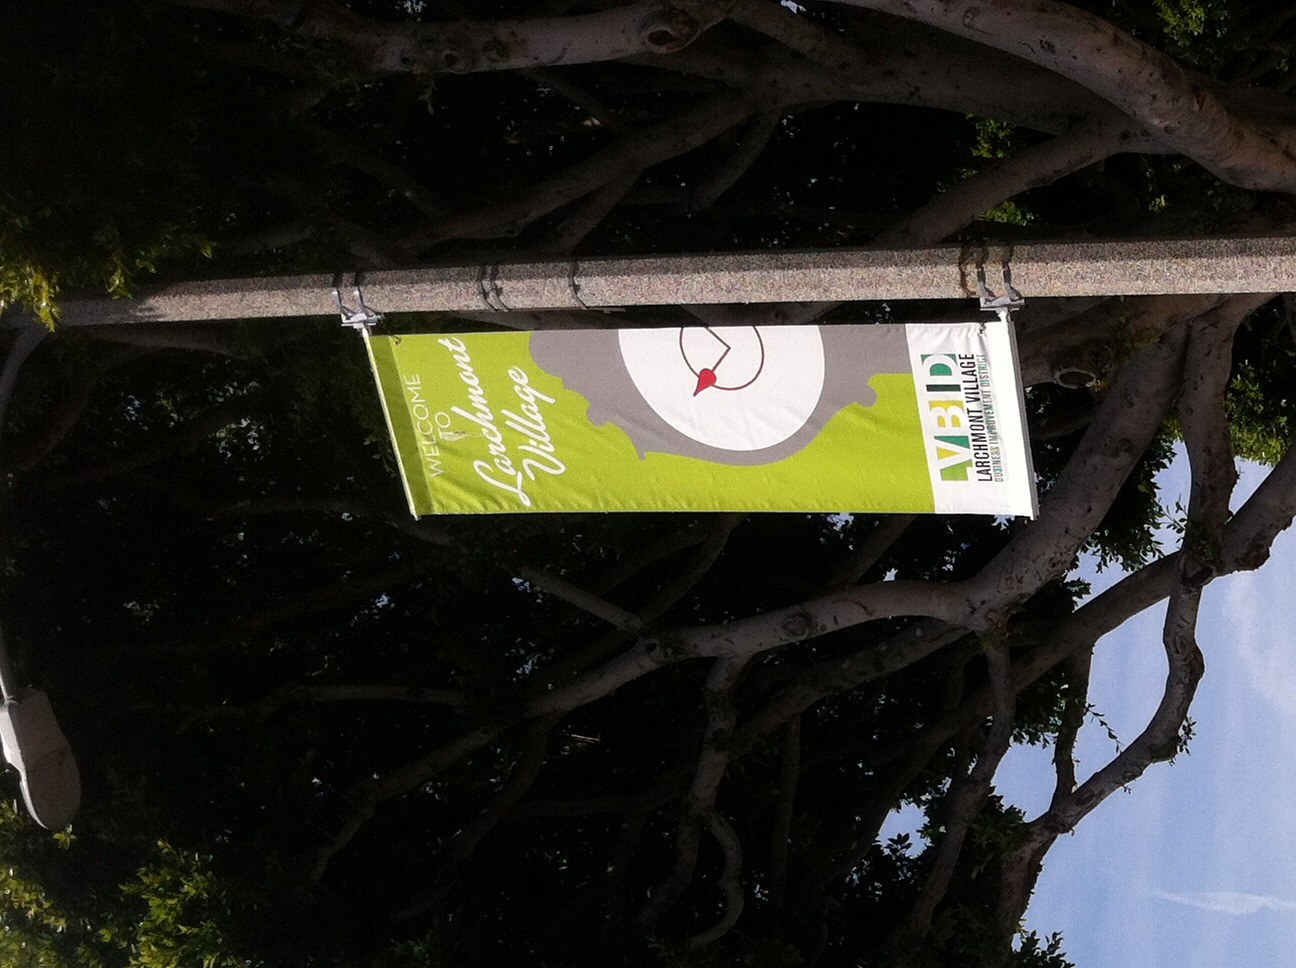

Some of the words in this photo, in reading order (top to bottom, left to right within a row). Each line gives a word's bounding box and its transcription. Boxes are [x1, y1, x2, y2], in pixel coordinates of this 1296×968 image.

[959, 354, 980, 403] VILLAGE
[405, 374, 445, 477] WELCOME
[434, 412, 451, 437] TO
[438, 337, 531, 506] Larchmont
[501, 367, 566, 481] Village
[967, 408, 992, 481] LARCHMONT
[981, 390, 999, 444] IMPROVEMENT
